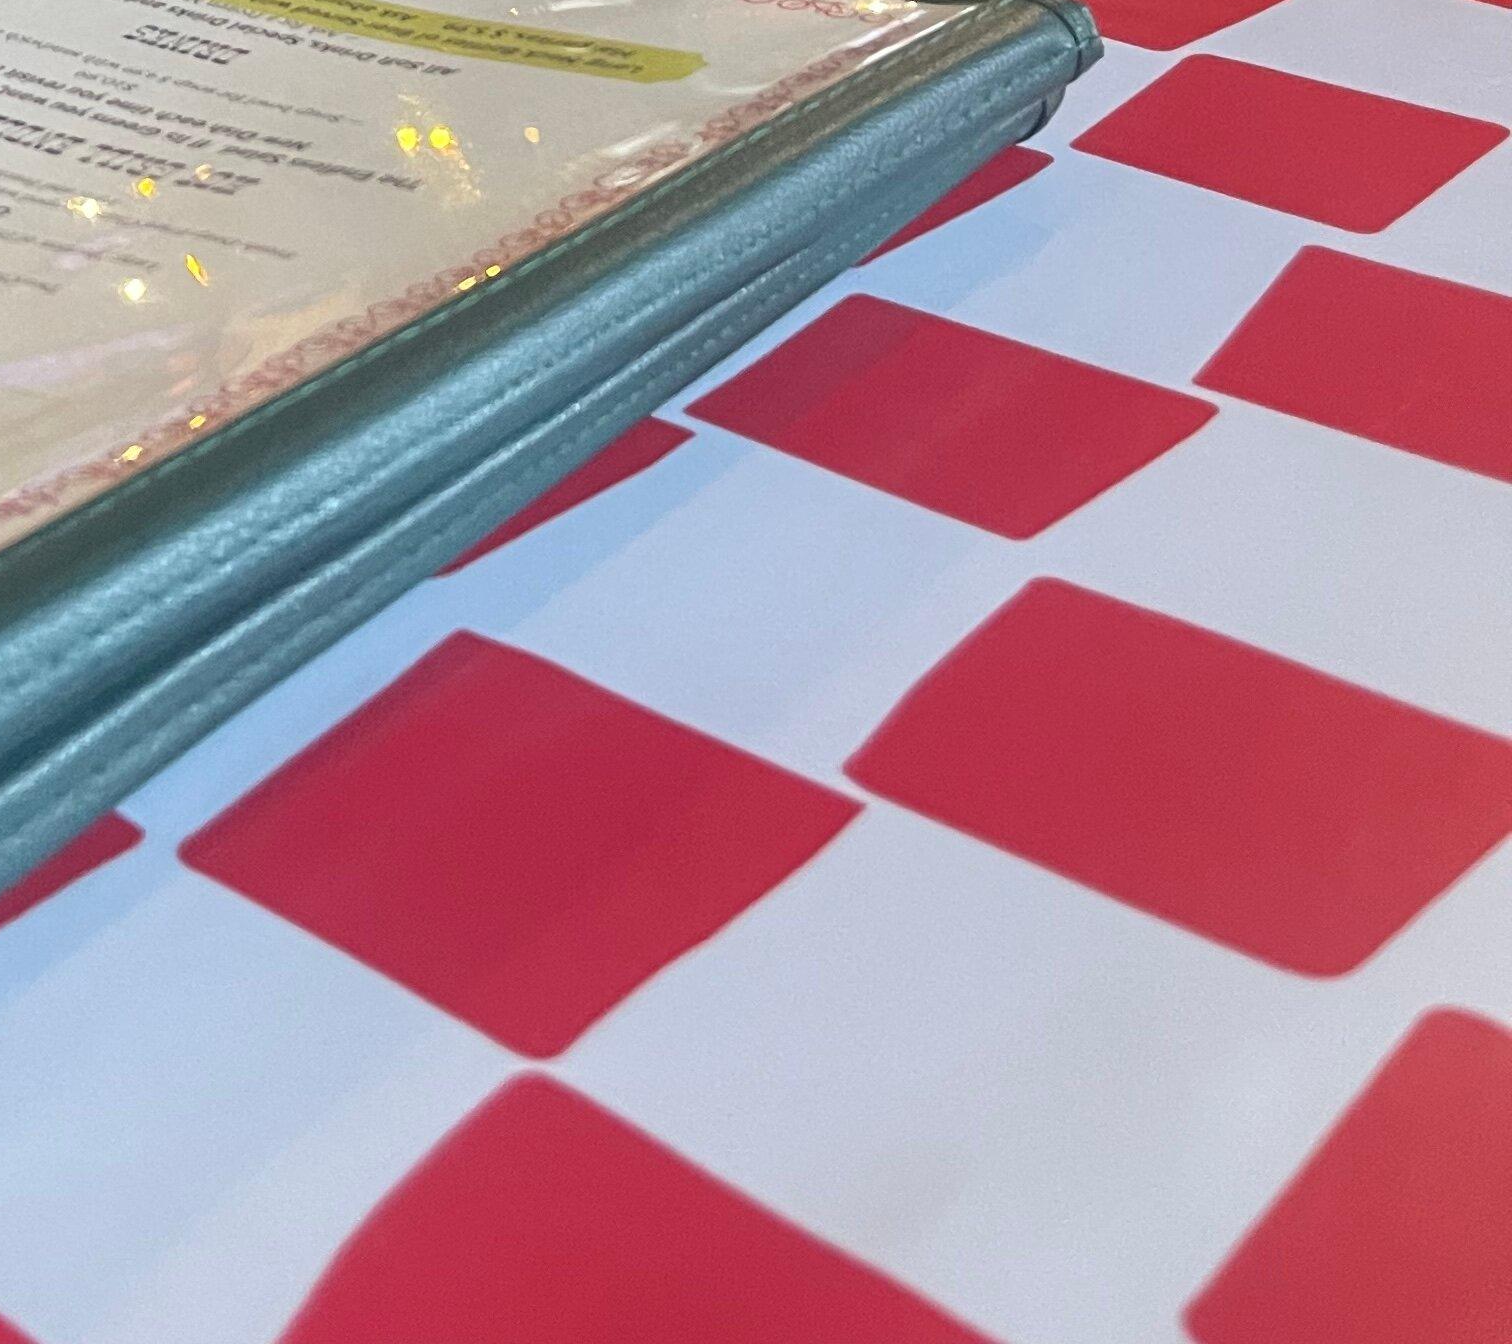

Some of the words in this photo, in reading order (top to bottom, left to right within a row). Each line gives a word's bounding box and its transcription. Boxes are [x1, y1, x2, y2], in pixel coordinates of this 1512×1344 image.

[167, 5, 229, 27] Drinks
[289, 5, 364, 28] Served
[377, 8, 419, 23] Ask
[227, 22, 303, 46] Special
[362, 21, 417, 39] Beer
[124, 24, 249, 65] DRINKS
[377, 56, 424, 71] Soft
[422, 64, 458, 76] All
[4, 69, 66, 91] revisit
[66, 86, 106, 102] you
[49, 101, 90, 118] you
[105, 98, 154, 116] time
[90, 113, 162, 137] Greens
[155, 111, 207, 128] each
[208, 124, 259, 142] Dish
[79, 143, 186, 180] GRILL
[288, 158, 374, 182] Endless
[378, 174, 421, 192] The
